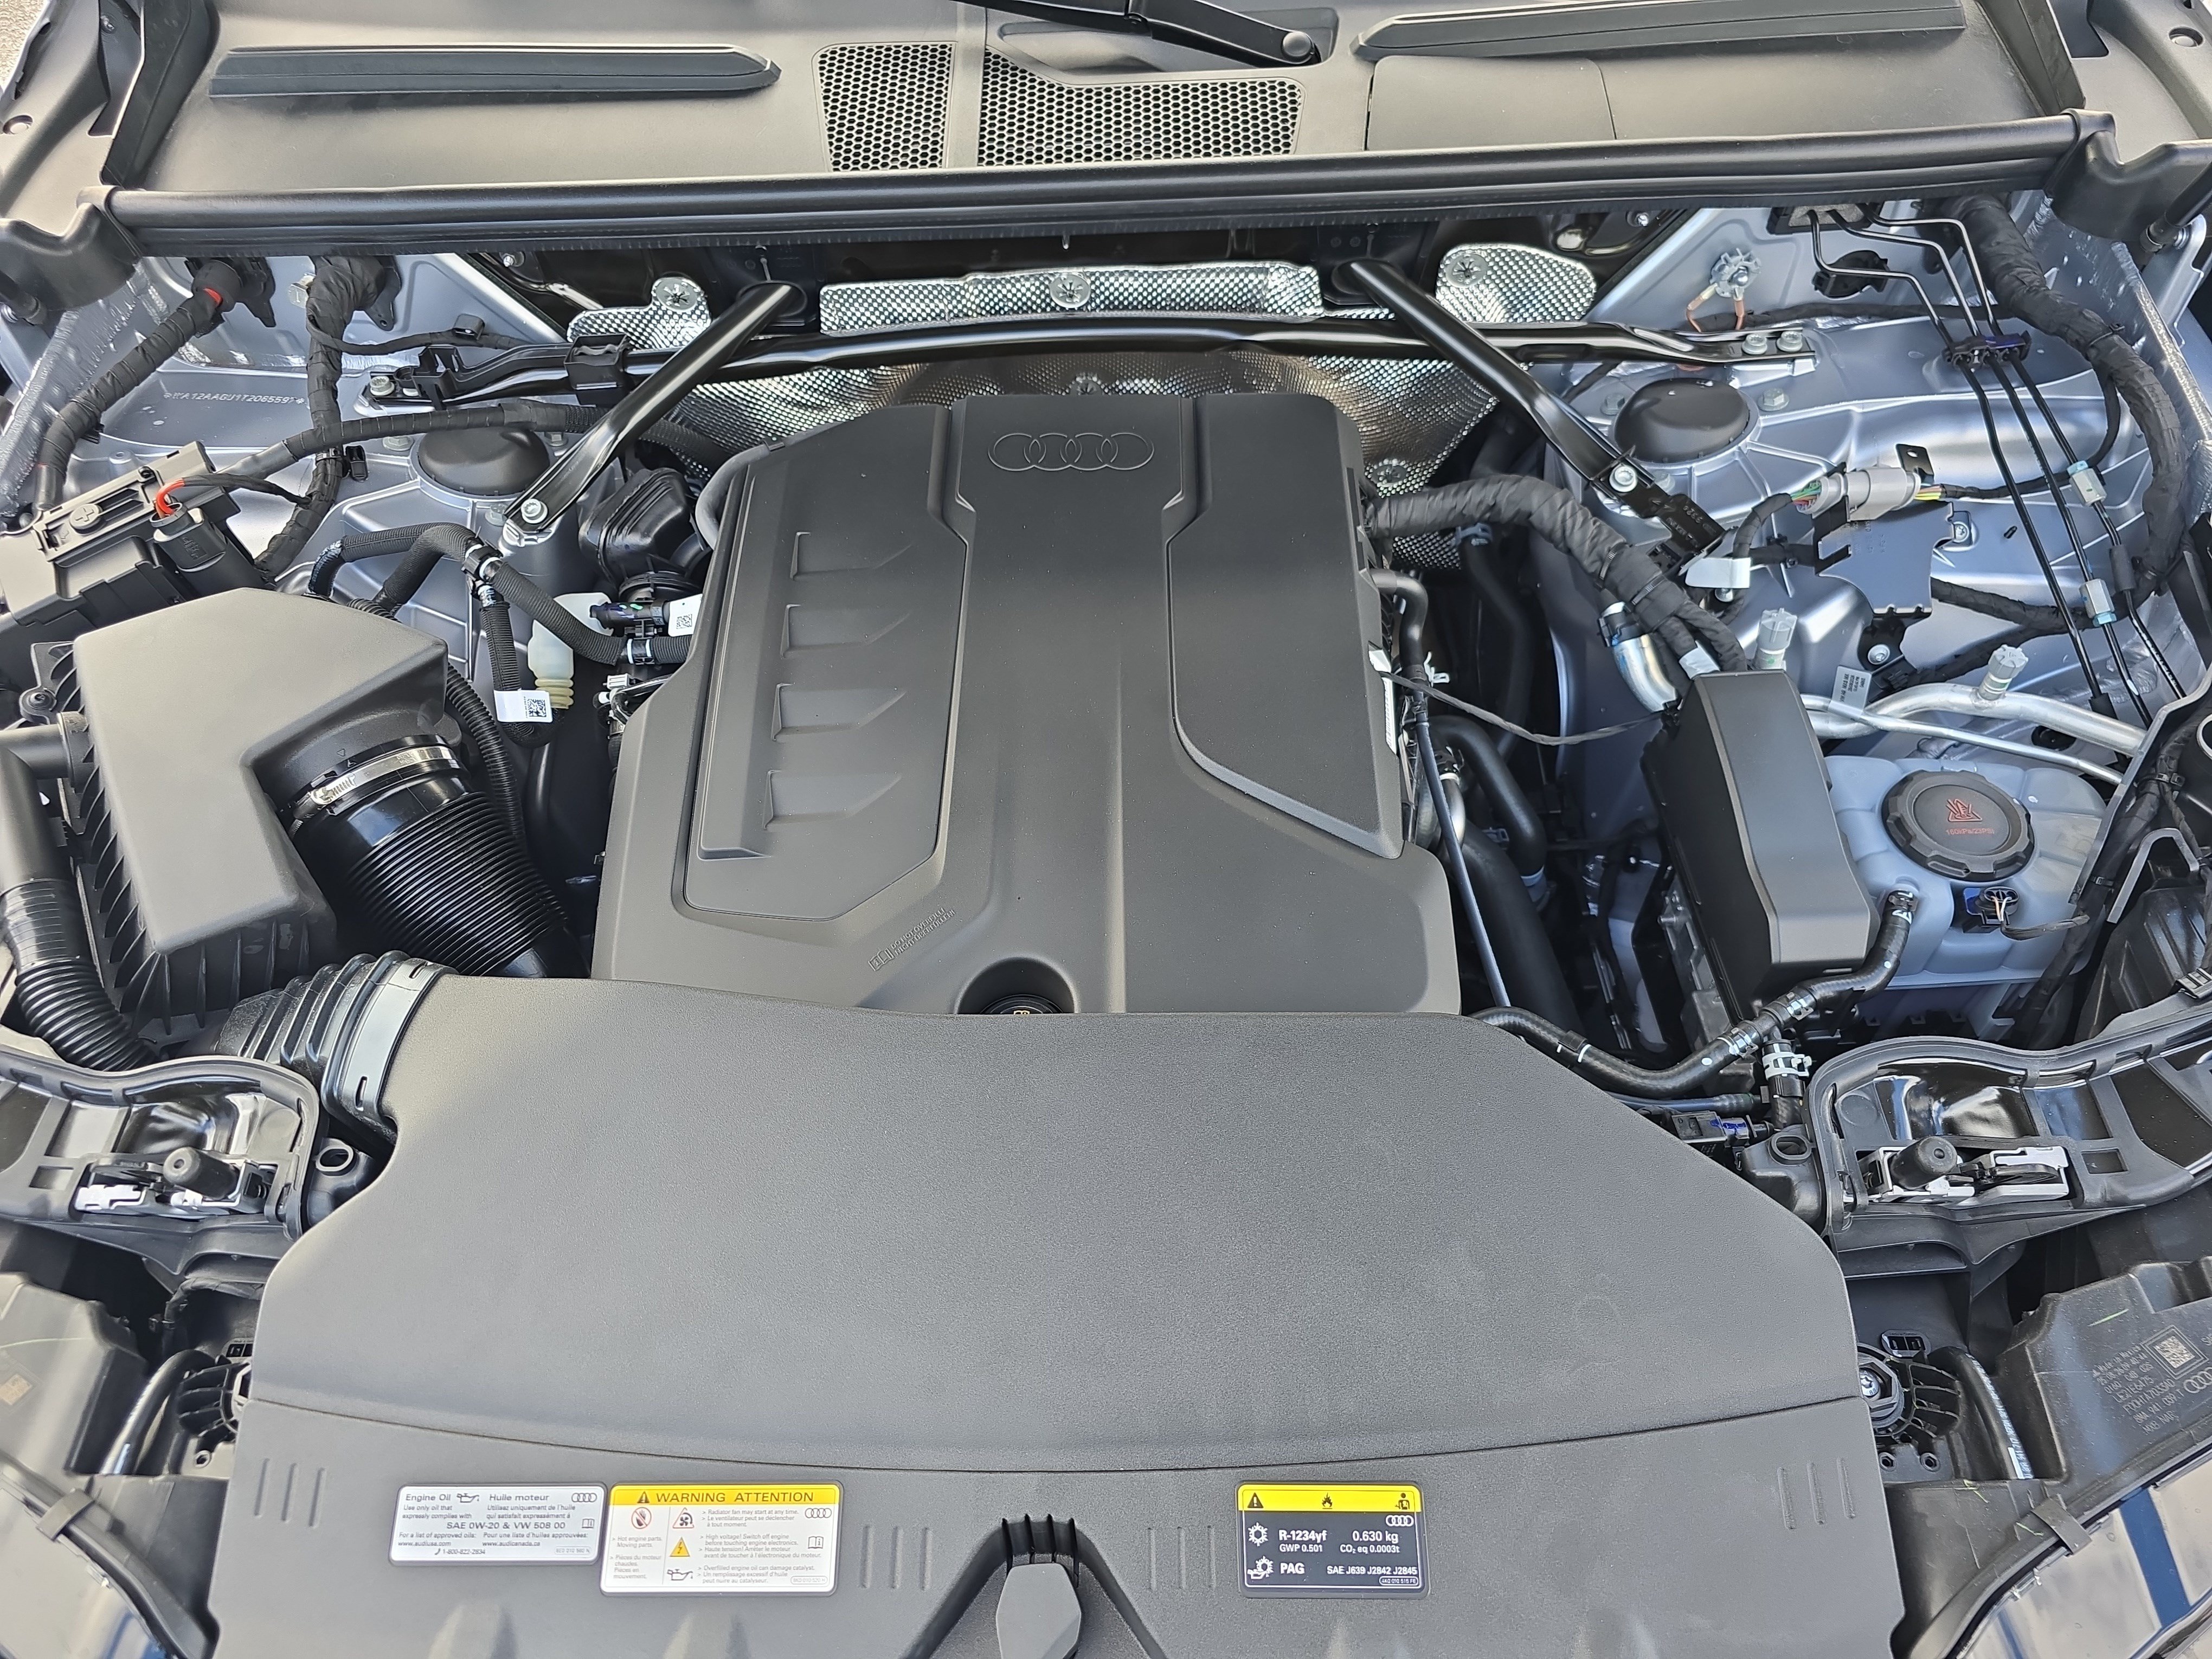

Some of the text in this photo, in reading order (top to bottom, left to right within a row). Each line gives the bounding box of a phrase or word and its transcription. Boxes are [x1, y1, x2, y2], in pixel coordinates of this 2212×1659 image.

[406, 1494, 435, 1502] Engine
[656, 1492, 814, 1502] WARNING ATTENTION
[1278, 1529, 1399, 1544] R-1234yf 0.630 kg
[1280, 1562, 1305, 1574] PAG
[1327, 1566, 1417, 1575] SAE J639 J2842 J2845
